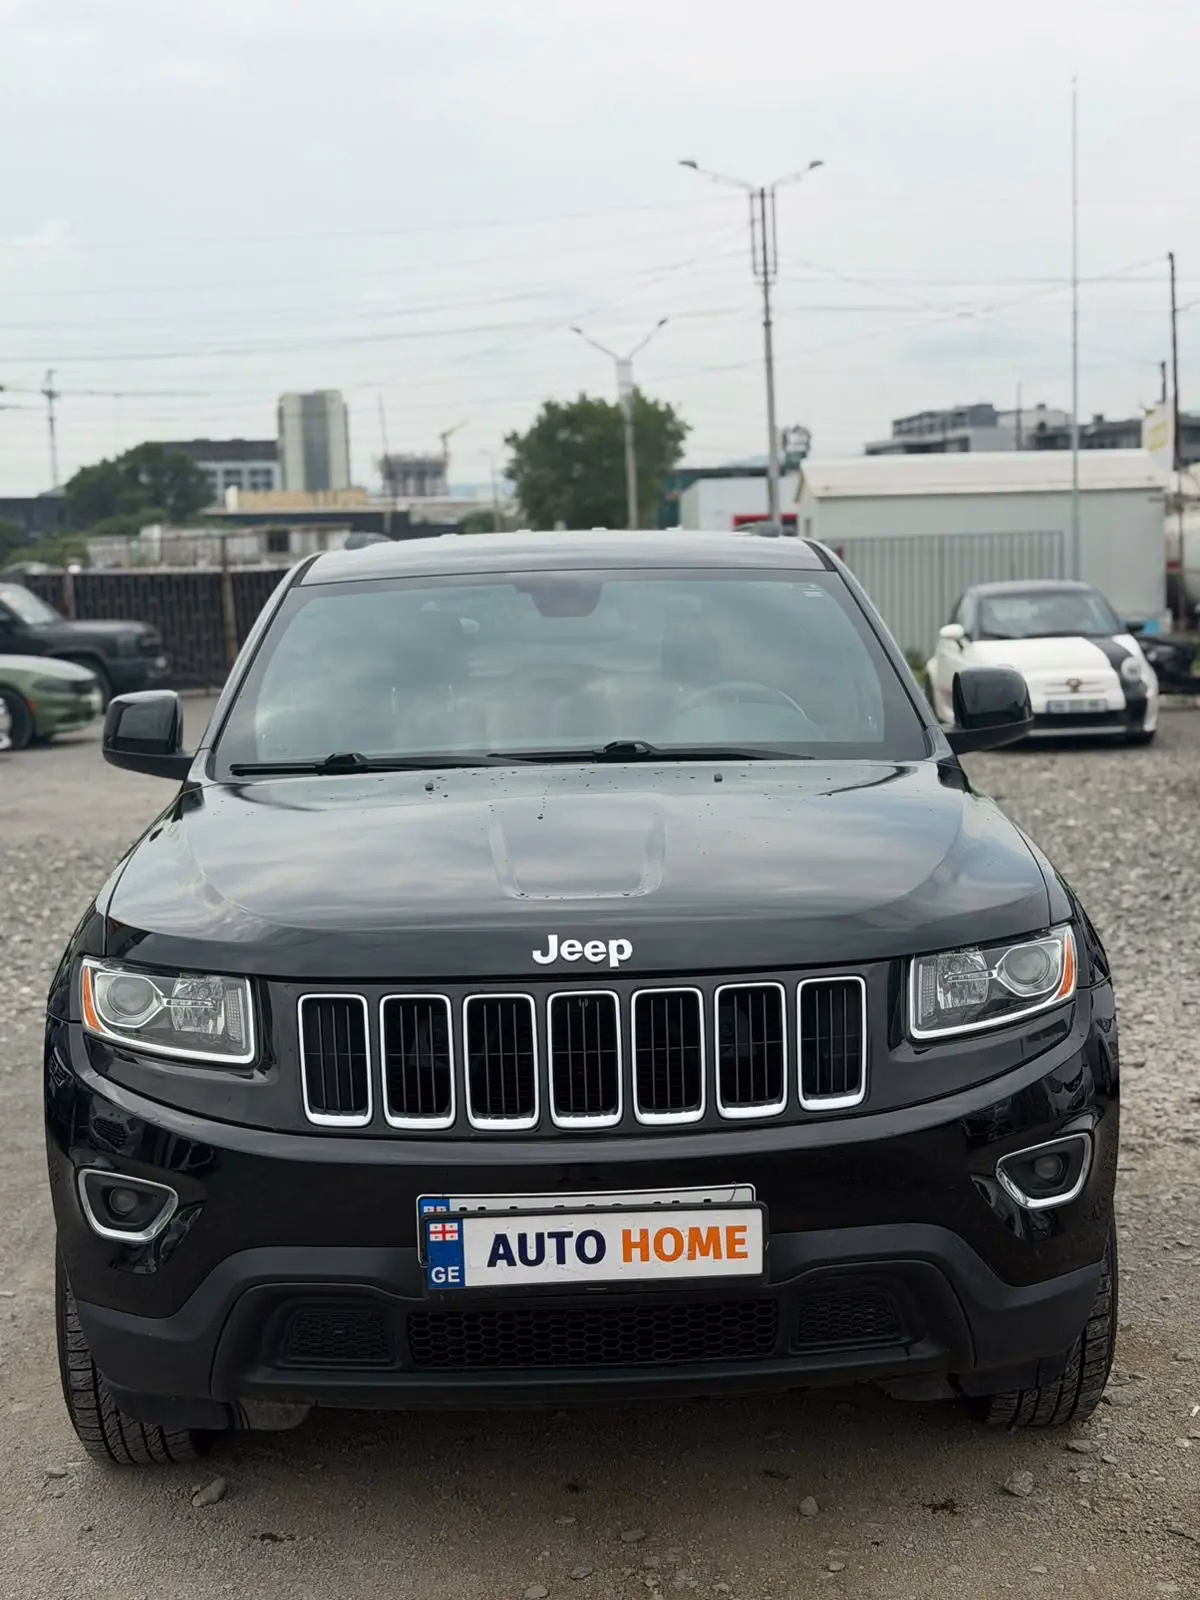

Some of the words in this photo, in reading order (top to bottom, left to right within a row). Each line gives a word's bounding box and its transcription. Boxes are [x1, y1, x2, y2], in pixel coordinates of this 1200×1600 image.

[532, 934, 633, 968] Jeep
[486, 1229, 607, 1268] AUTO
[621, 1225, 749, 1264] HOME
[431, 1266, 460, 1284] GE
